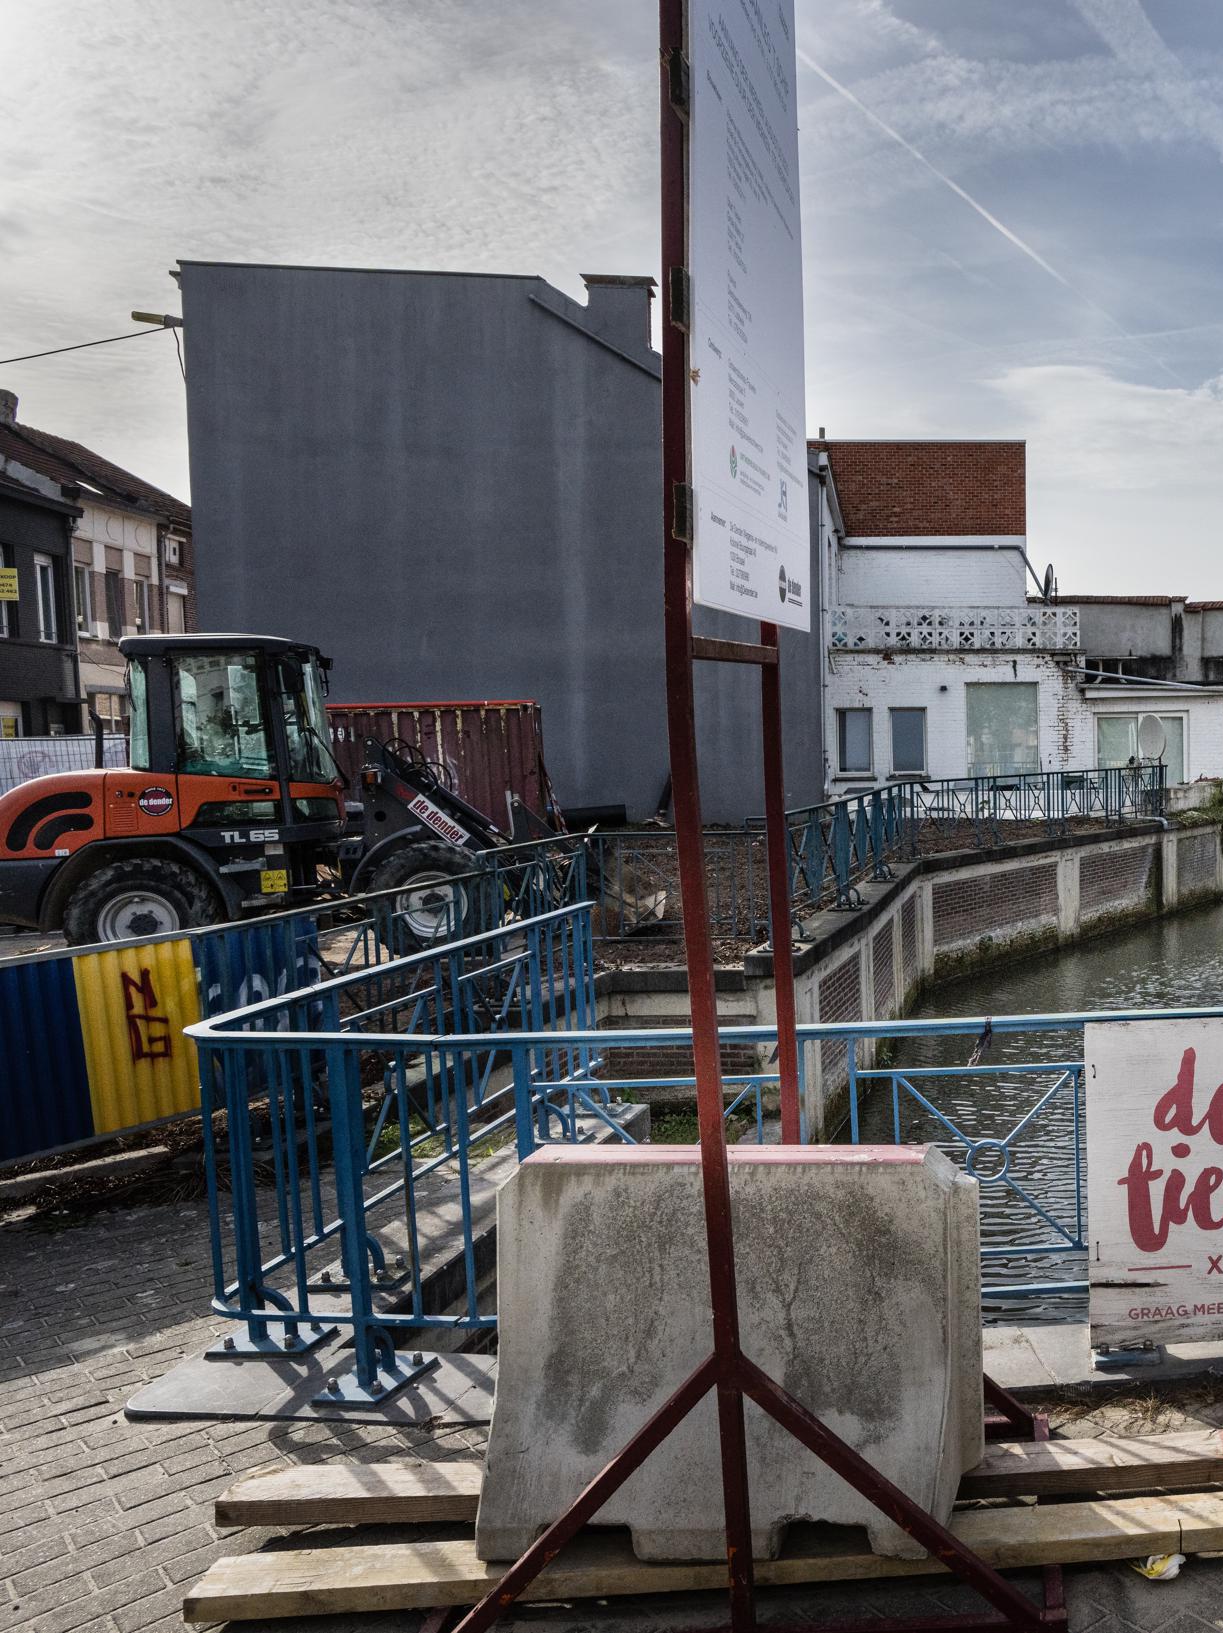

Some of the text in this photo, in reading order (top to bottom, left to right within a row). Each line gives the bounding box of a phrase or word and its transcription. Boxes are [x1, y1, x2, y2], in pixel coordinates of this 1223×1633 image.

[148, 797, 173, 806] dender
[412, 799, 465, 842] de dender
[220, 829, 279, 844] TL 65
[1128, 1304, 1189, 1321] GRAAG
